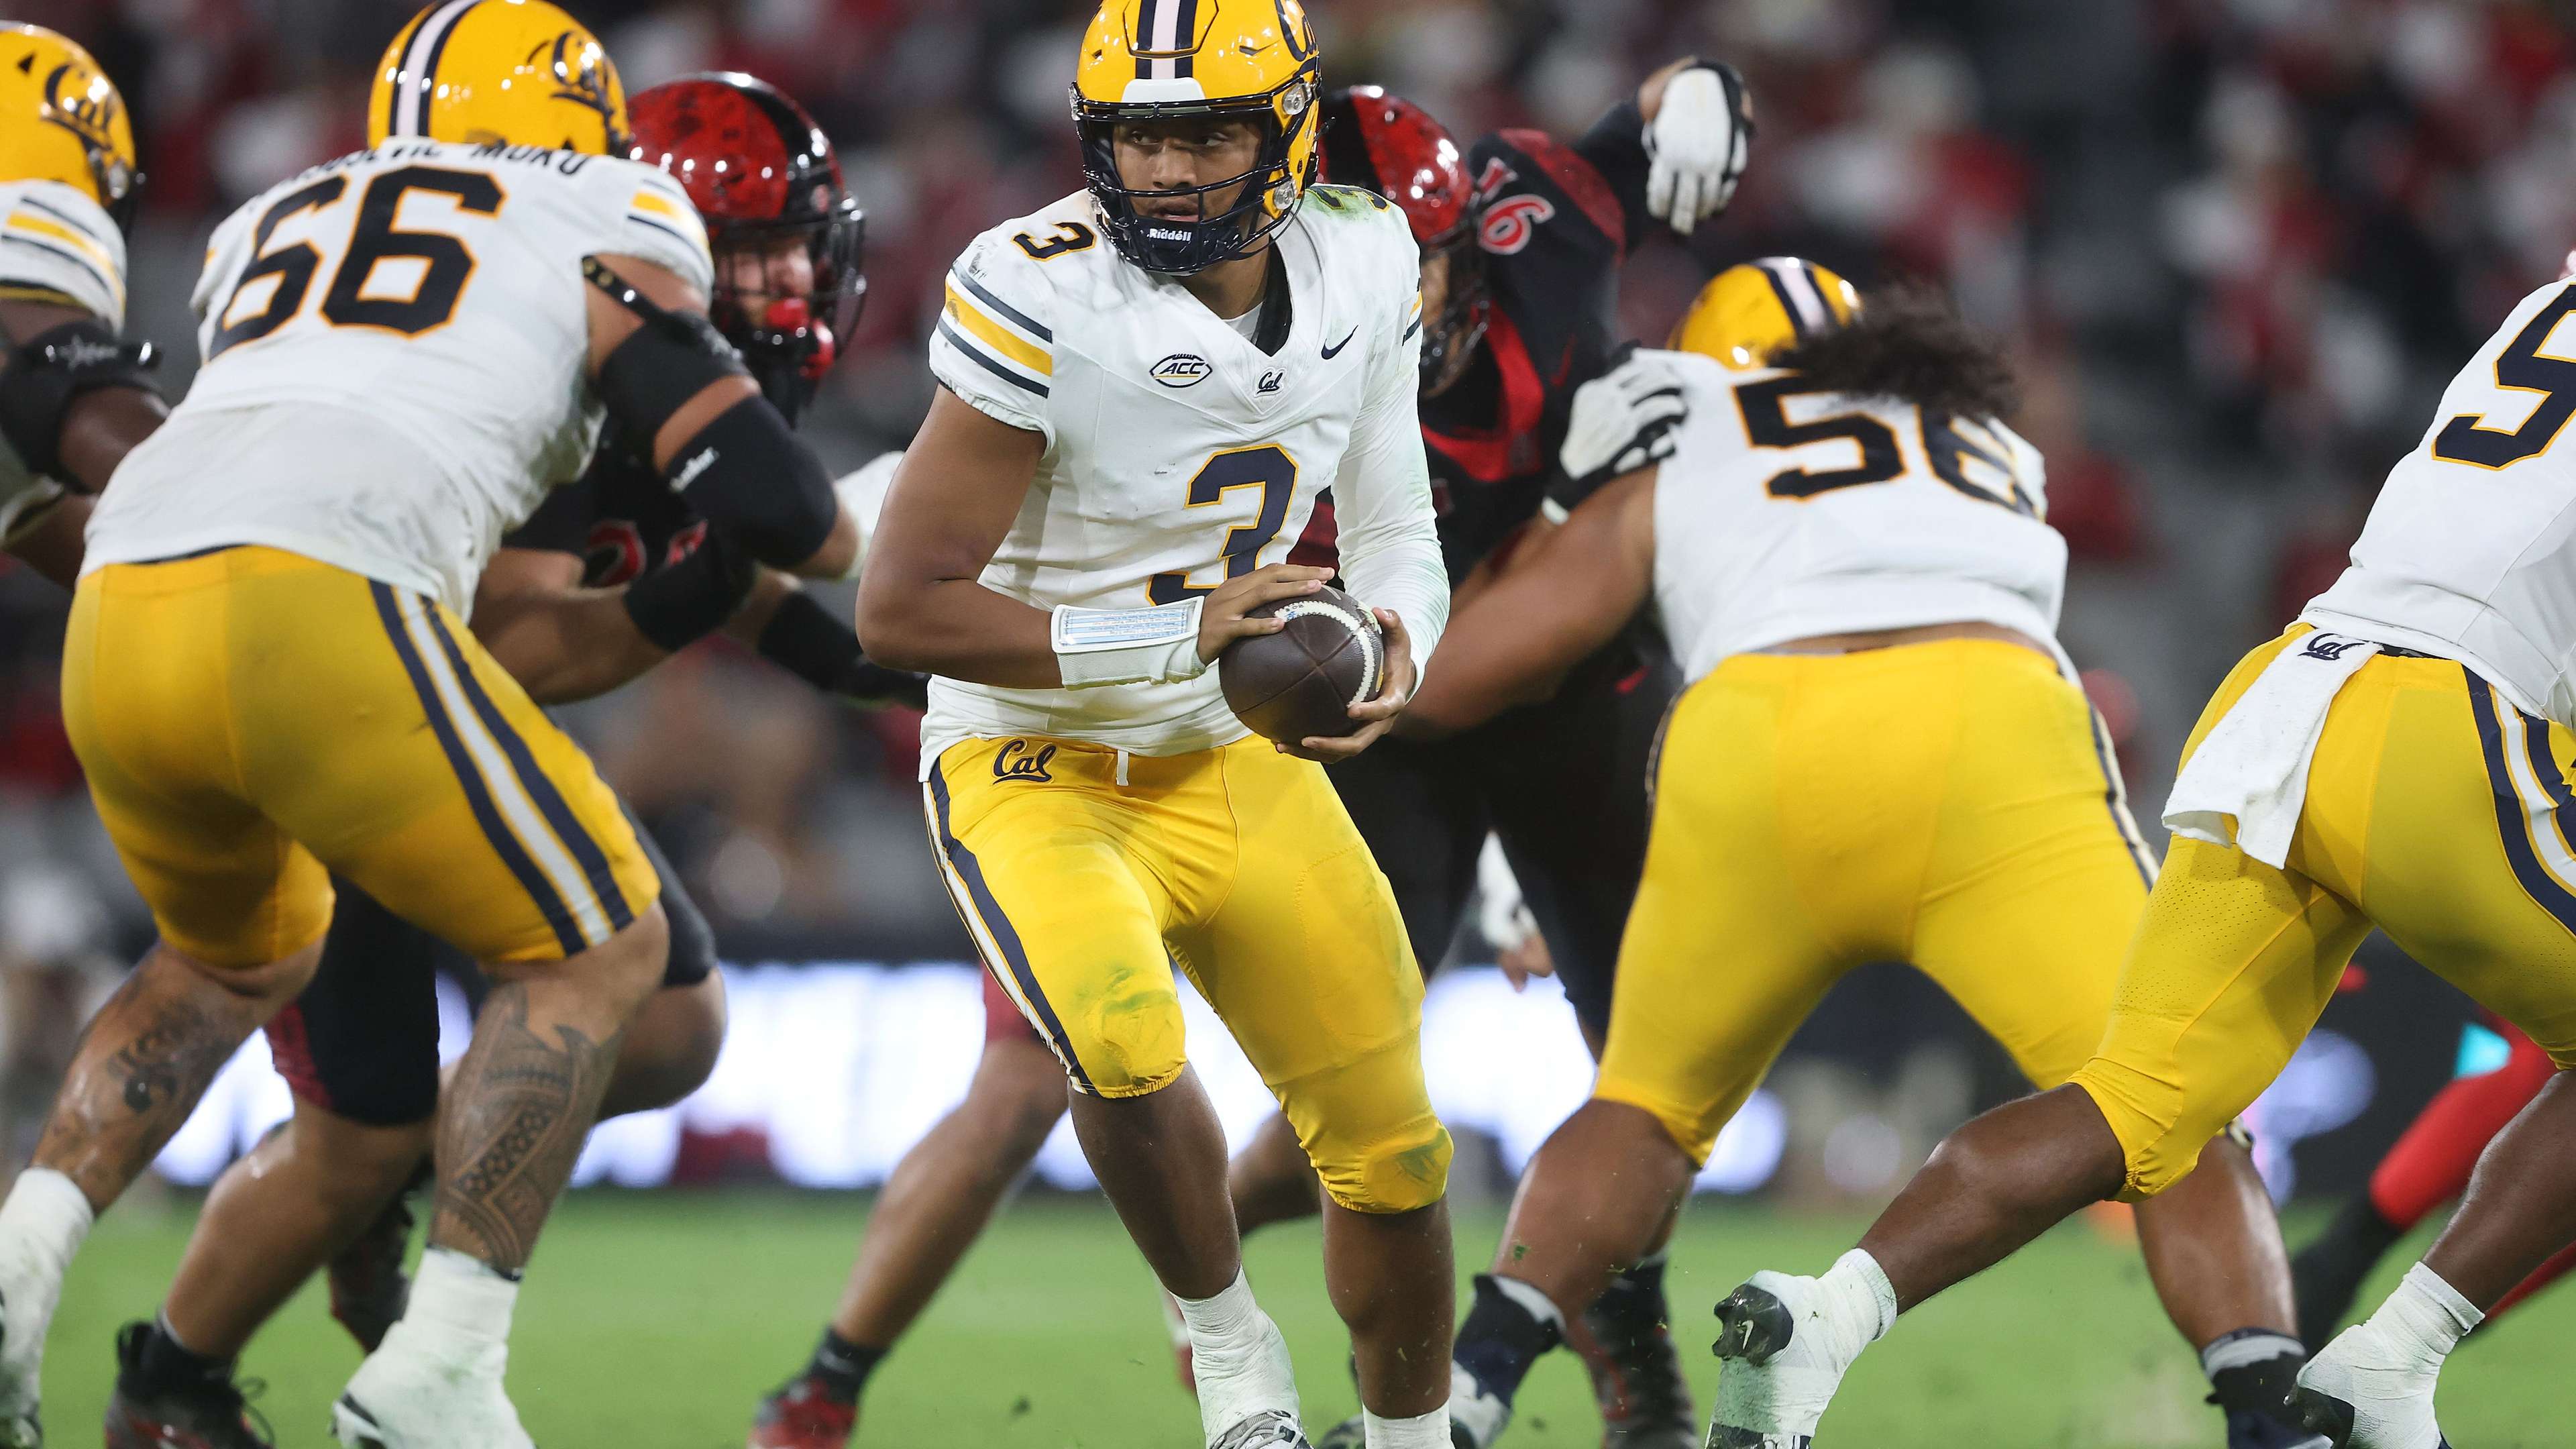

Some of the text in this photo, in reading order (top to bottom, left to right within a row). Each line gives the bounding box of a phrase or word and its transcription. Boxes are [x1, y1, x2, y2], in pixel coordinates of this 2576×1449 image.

[1011, 221, 1097, 262] 3
[1149, 228, 1192, 241] Riddell
[207, 165, 508, 365] 66
[1257, 372, 1283, 394] Cal
[1144, 442, 1299, 607] 3
[2297, 633, 2365, 660] Cal
[993, 740, 1057, 785] Cal
